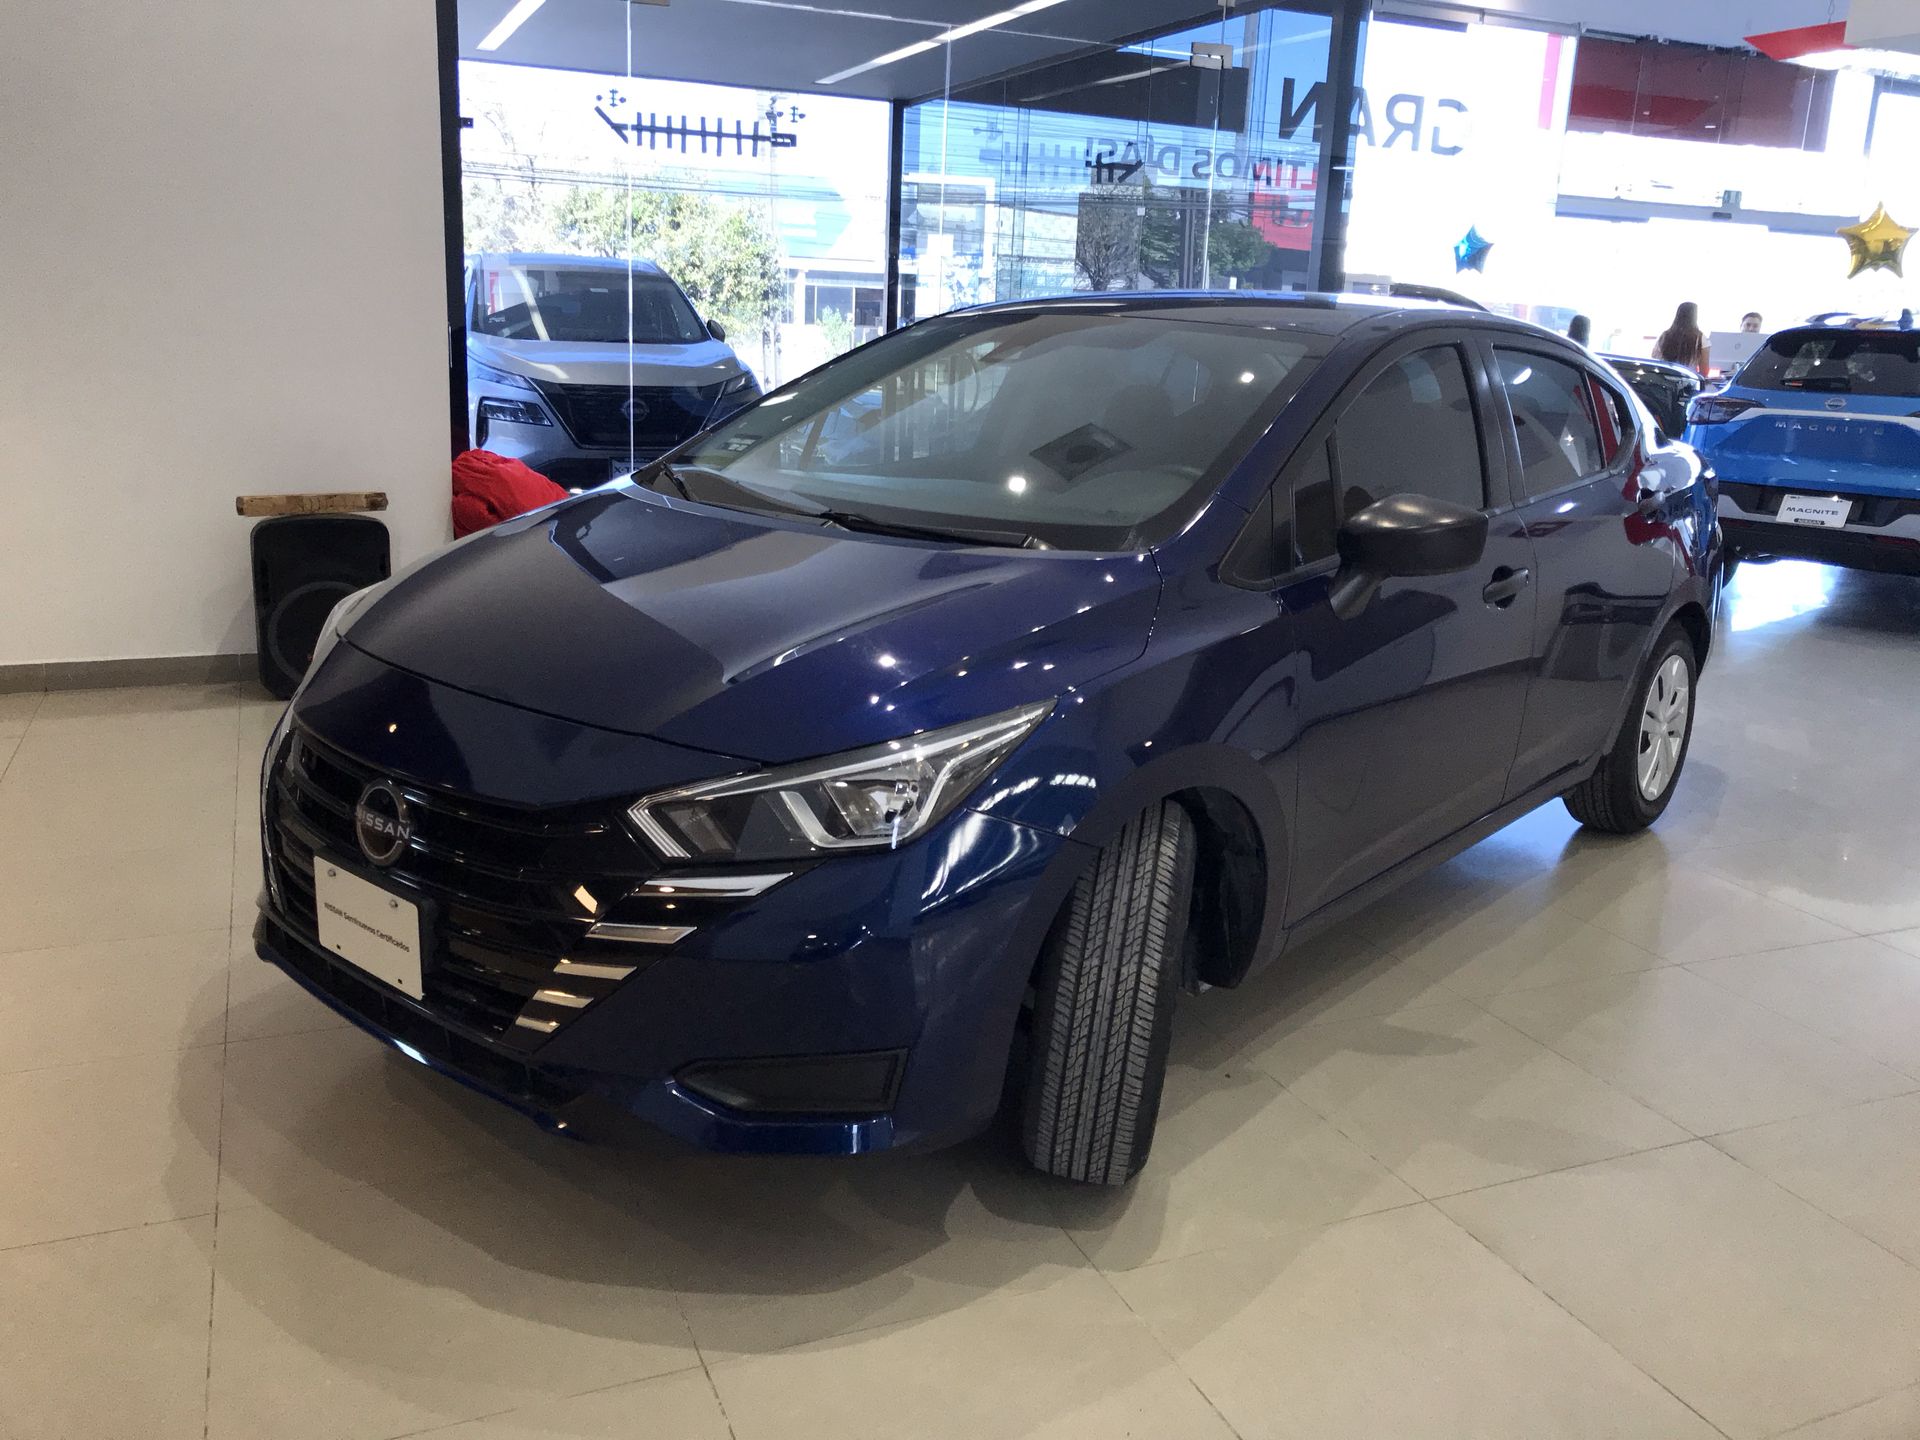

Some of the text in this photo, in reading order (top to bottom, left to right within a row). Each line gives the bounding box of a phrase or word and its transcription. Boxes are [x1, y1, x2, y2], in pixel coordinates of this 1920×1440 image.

[1775, 421, 1884, 436] MAGNITE
[1786, 506, 1840, 516] MAGNITE
[355, 805, 410, 840] NISSAN
